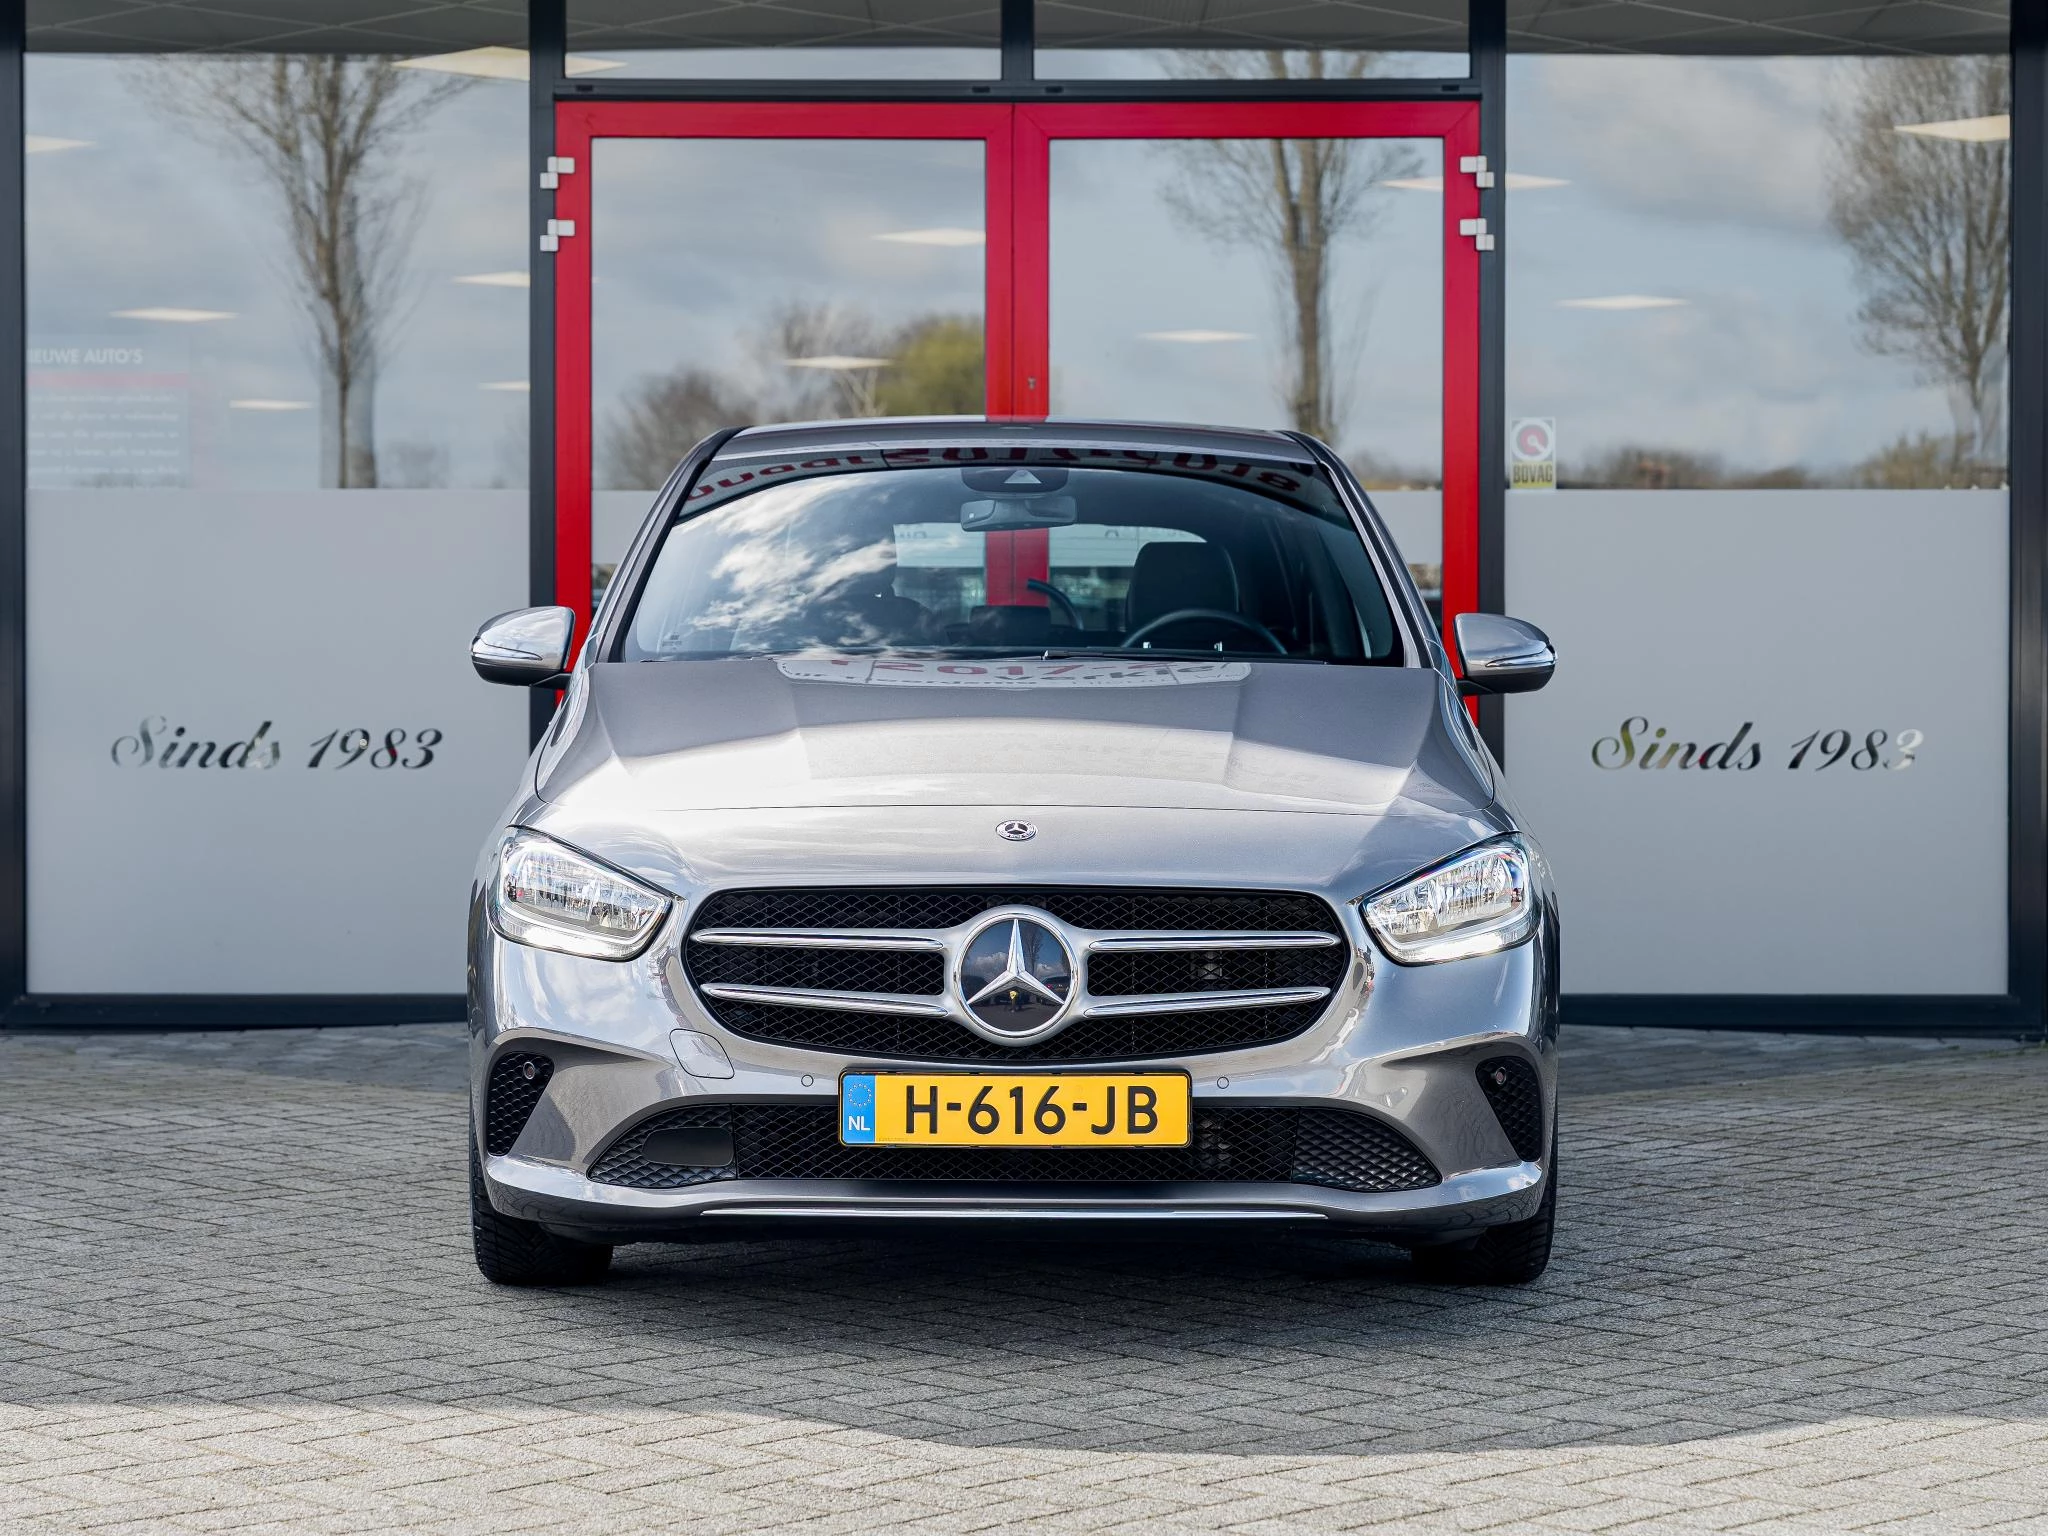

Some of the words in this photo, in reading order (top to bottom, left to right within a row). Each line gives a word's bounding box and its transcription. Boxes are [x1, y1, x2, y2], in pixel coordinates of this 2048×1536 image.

[83, 348, 143, 365] AUTO'S
[1513, 463, 1553, 484] BOVAG
[110, 714, 281, 770] Sinds
[307, 727, 444, 770] 1983
[1591, 715, 1761, 771] Sinds
[1787, 728, 1925, 771] 1983
[847, 1115, 871, 1131] NL
[905, 1085, 1159, 1135] H-616-JB
